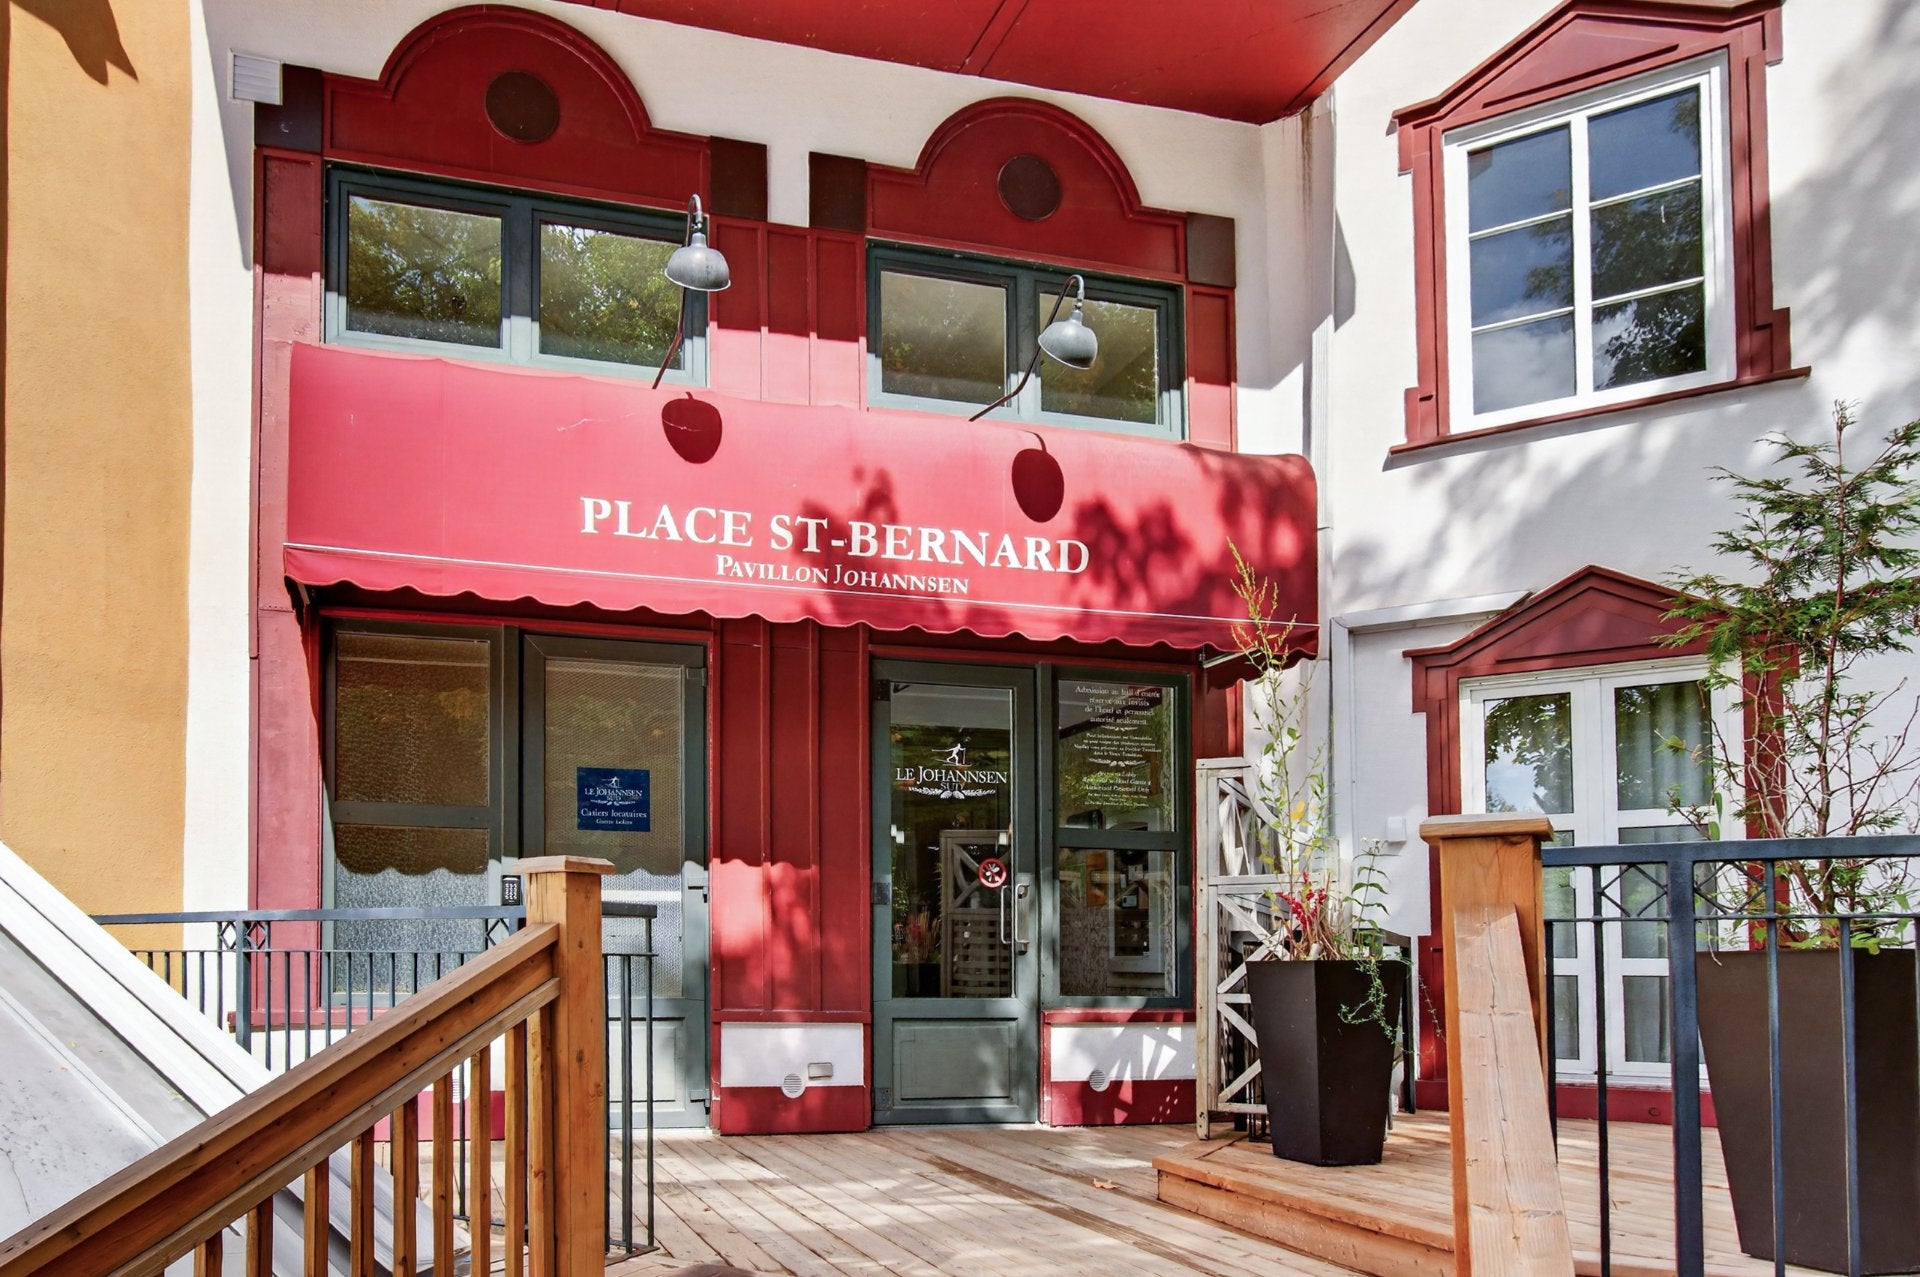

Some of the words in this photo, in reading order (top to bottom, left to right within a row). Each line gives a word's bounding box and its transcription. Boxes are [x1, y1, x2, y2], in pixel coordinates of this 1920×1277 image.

[580, 496, 753, 547] PLACE
[770, 514, 1090, 574] ST-BERNARD
[833, 564, 969, 594] JOHANNSEN
[895, 767, 915, 781] LE
[917, 765, 1008, 784] JOHANNSEN
[584, 787, 595, 795] LE
